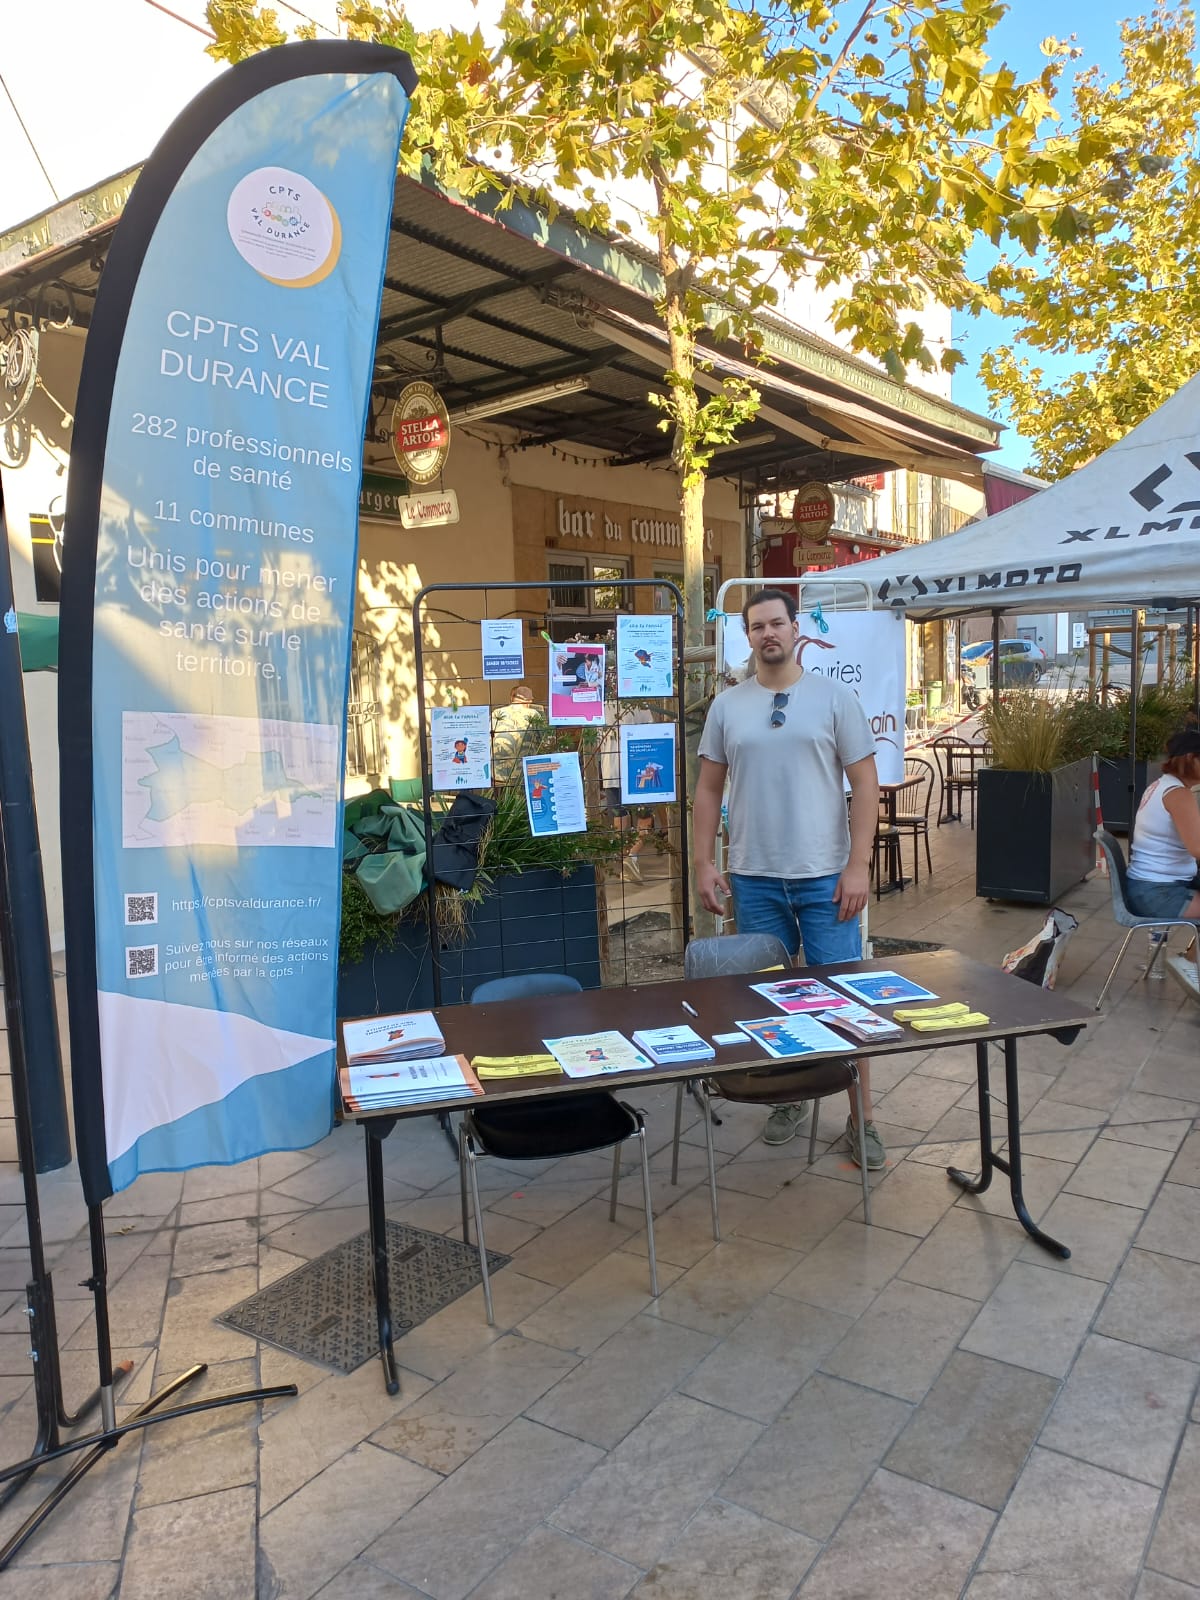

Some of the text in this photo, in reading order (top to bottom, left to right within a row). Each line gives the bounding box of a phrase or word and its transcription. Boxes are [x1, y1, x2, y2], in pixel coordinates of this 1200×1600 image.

[269, 185, 301, 201] CPTS
[251, 207, 263, 226] VAL
[266, 222, 311, 239] DURANCE
[166, 310, 330, 371] CPTS VAL
[160, 349, 330, 409] DURANCE
[401, 419, 440, 436] STELLA
[402, 430, 441, 447] ARTOIS
[131, 412, 178, 440] 282
[186, 423, 353, 474] professionnels
[193, 456, 292, 492] de santé
[405, 500, 452, 520] Le Commerce
[800, 503, 828, 513] STELLA
[800, 510, 829, 520] ARTOIS
[153, 500, 315, 544] 11 communes
[559, 499, 714, 551] bar du comme
[127, 545, 337, 594] Unis pour mener
[140, 580, 320, 622] des actions de
[159, 619, 301, 652] santé sur le
[176, 649, 282, 681] territoire.
[868, 711, 897, 735] ain
[165, 942, 204, 956] Suivez
[234, 939, 254, 949] sur
[257, 939, 279, 950] nos
[282, 937, 329, 949] réseaux
[165, 959, 191, 974] pour
[214, 951, 258, 964] informé
[262, 952, 284, 964] des
[287, 950, 329, 962] actions
[233, 967, 252, 979] par
[255, 965, 266, 977] la
[270, 966, 294, 979] cpts
